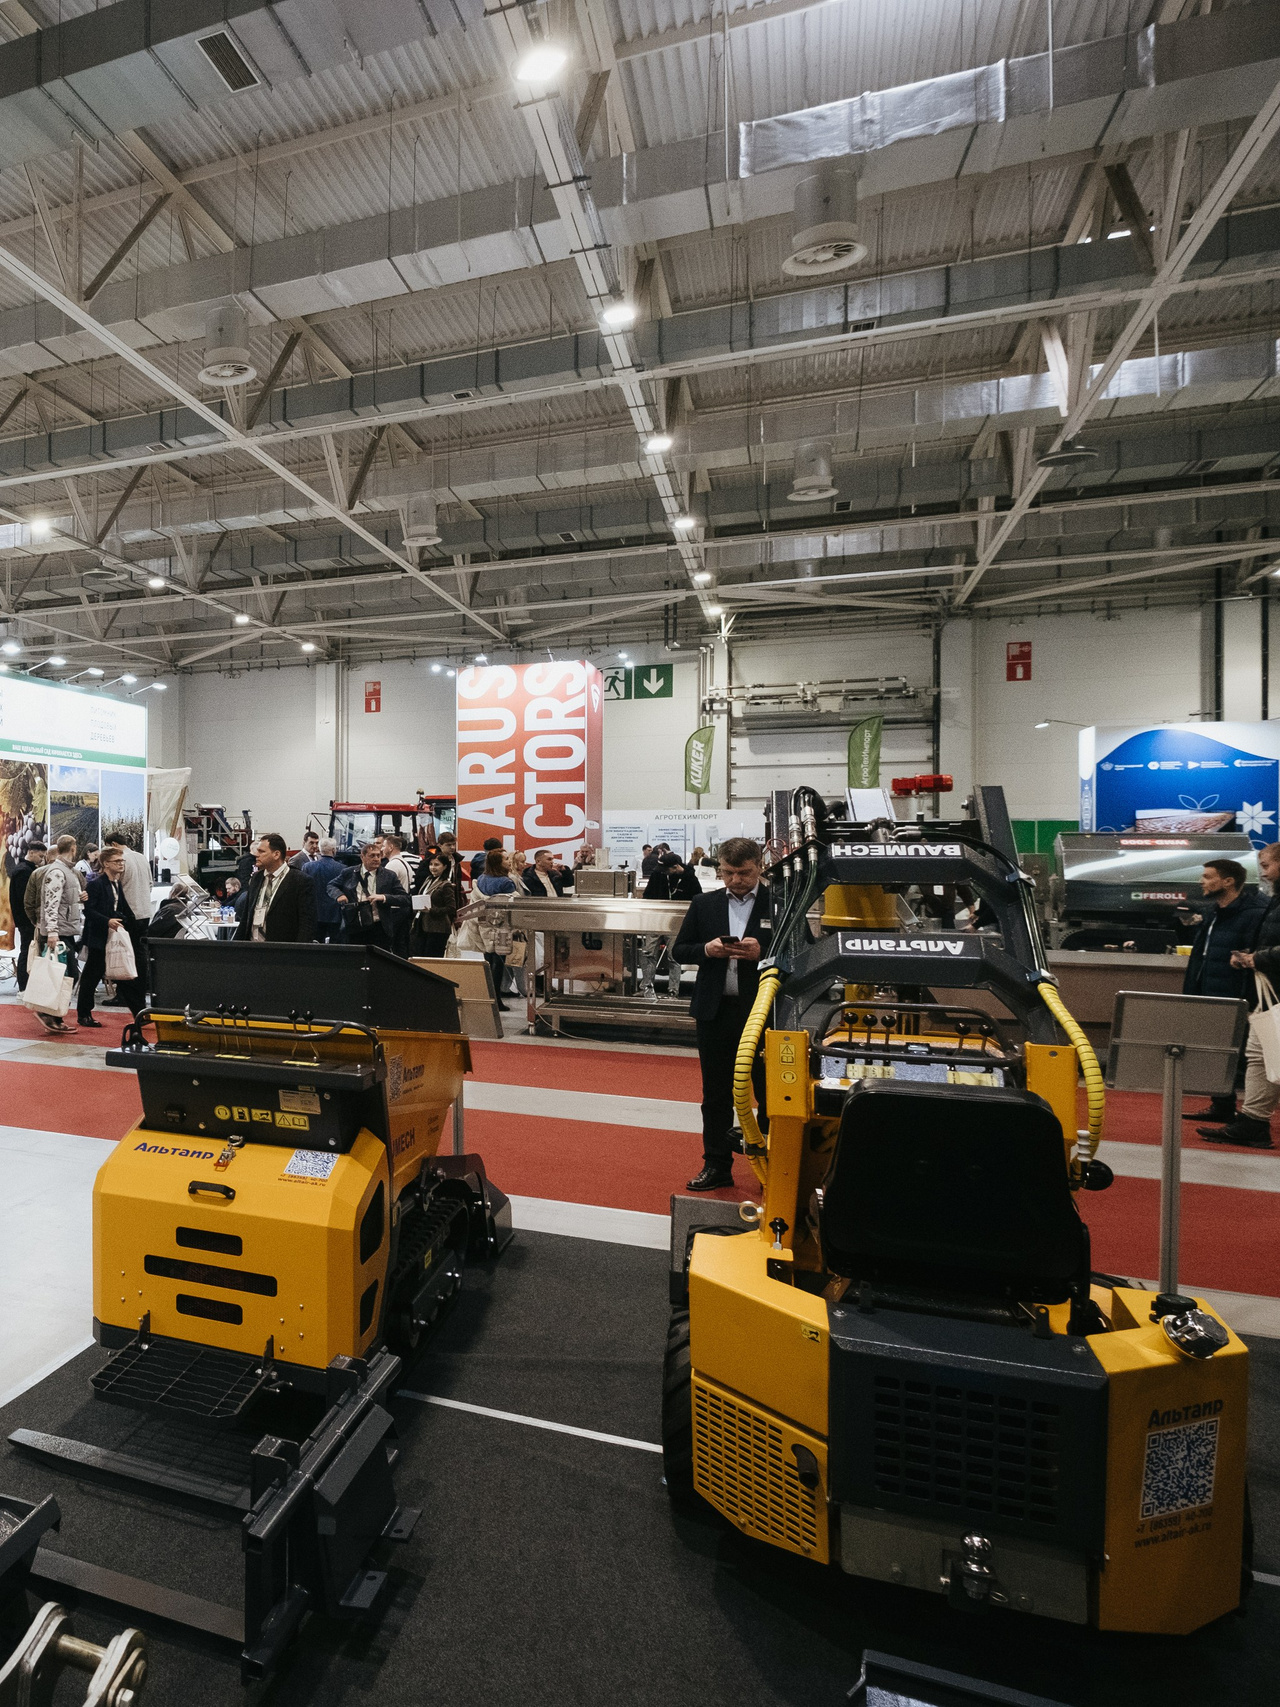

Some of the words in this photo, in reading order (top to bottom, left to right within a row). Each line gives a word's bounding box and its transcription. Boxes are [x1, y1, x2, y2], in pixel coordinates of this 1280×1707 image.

[90, 732, 115, 743] ДЕРЕВЬЕВ
[690, 739, 705, 788] KUKER
[655, 813, 718, 821] АГРОТЕХИМПОРТ
[834, 844, 962, 856] BAUMECH
[1143, 892, 1186, 900] FEROLL
[845, 939, 965, 955] Альтаир
[134, 1142, 215, 1160] Альтаир
[1148, 1399, 1224, 1429] Альтаир
